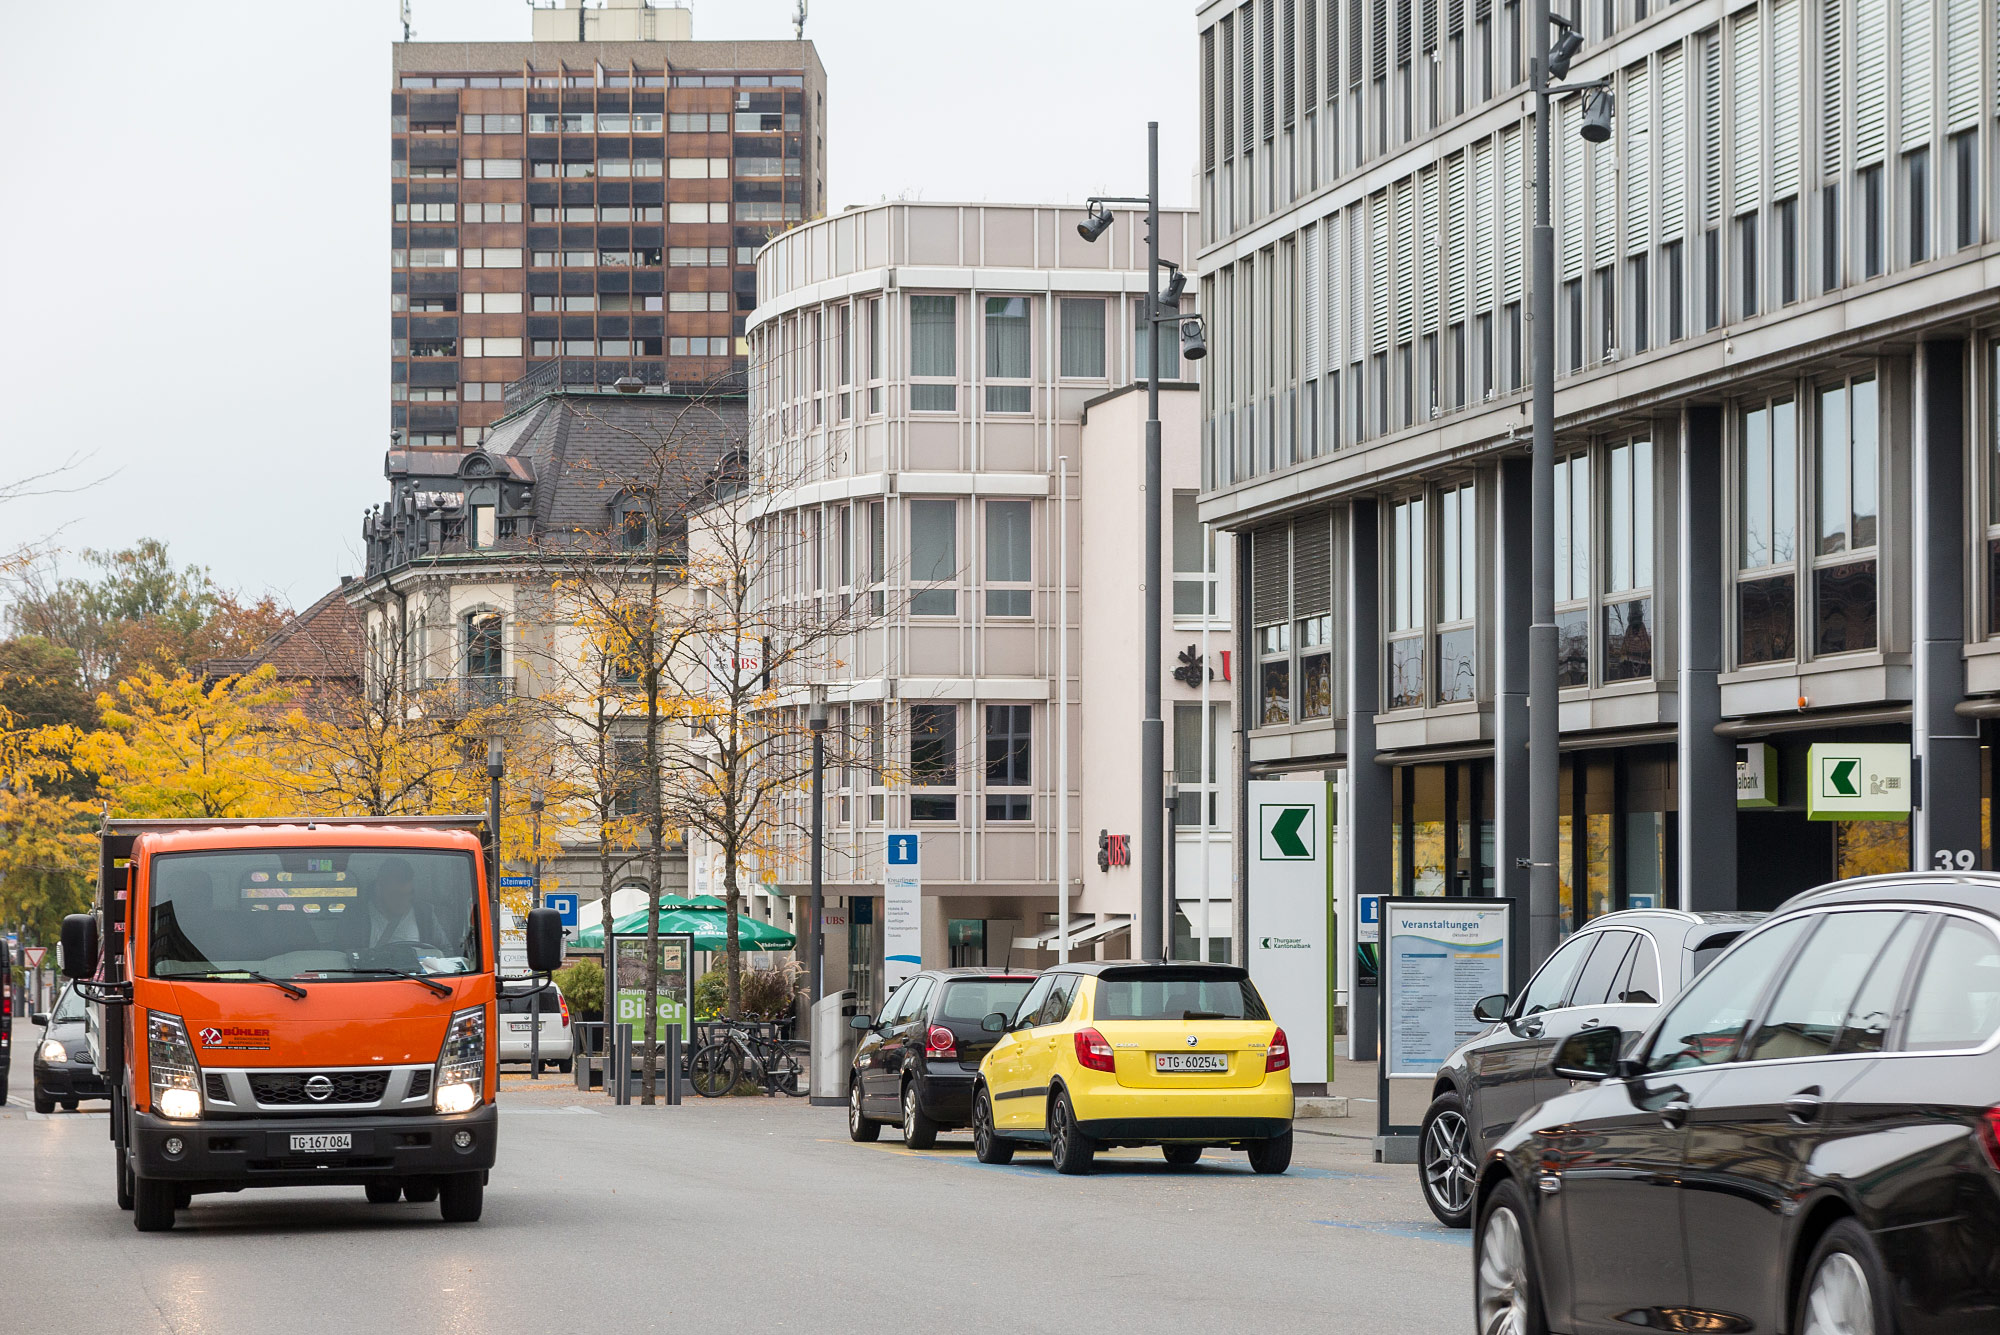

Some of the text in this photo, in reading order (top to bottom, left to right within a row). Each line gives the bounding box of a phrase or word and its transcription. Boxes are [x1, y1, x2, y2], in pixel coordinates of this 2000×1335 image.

[1736, 773, 1758, 790] albank
[1107, 834, 1130, 866] UBS
[1934, 849, 1975, 871] 39
[502, 877, 531, 887] Steinweg
[825, 916, 845, 925] UBS
[1401, 920, 1479, 931] Veranstaltungen
[504, 954, 527, 963] GOLDIN
[620, 987, 669, 996] Baumter
[620, 998, 684, 1019] Bier
[223, 1027, 270, 1036] BÜHLER
